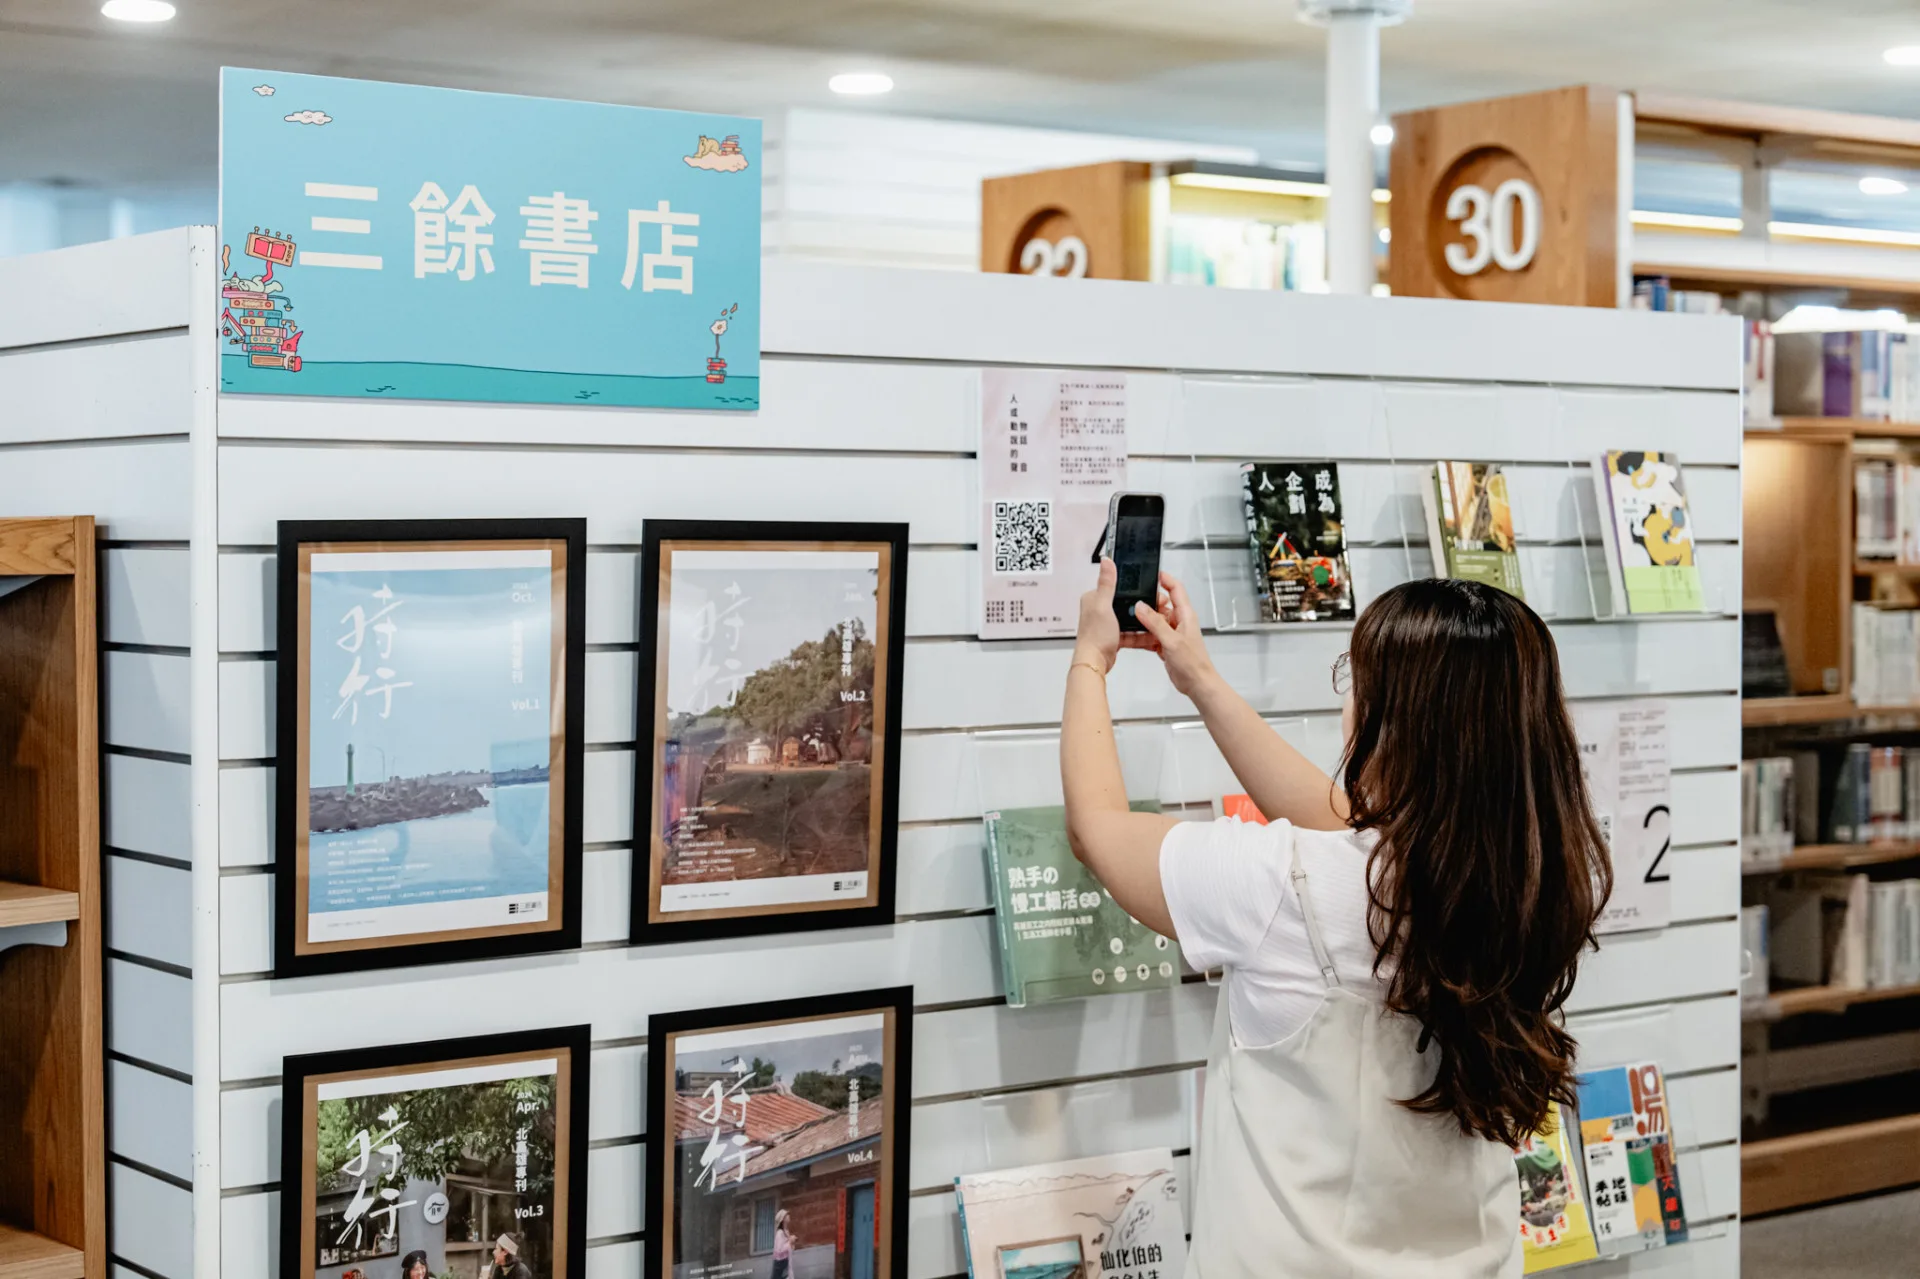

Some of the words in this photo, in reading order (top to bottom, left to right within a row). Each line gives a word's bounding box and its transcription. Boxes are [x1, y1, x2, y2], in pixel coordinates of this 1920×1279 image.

[1445, 178, 1541, 276] 30
[299, 181, 700, 295] 三餘書店
[1258, 472, 1275, 491] 人
[1285, 471, 1306, 514] 企劃
[1315, 470, 1335, 514] 成為
[512, 698, 540, 710] Vol.1
[840, 690, 866, 702] Vol.2
[516, 1101, 540, 1114] Apr.
[847, 1149, 873, 1163] Vol.4
[514, 1204, 544, 1219] Vol.3
